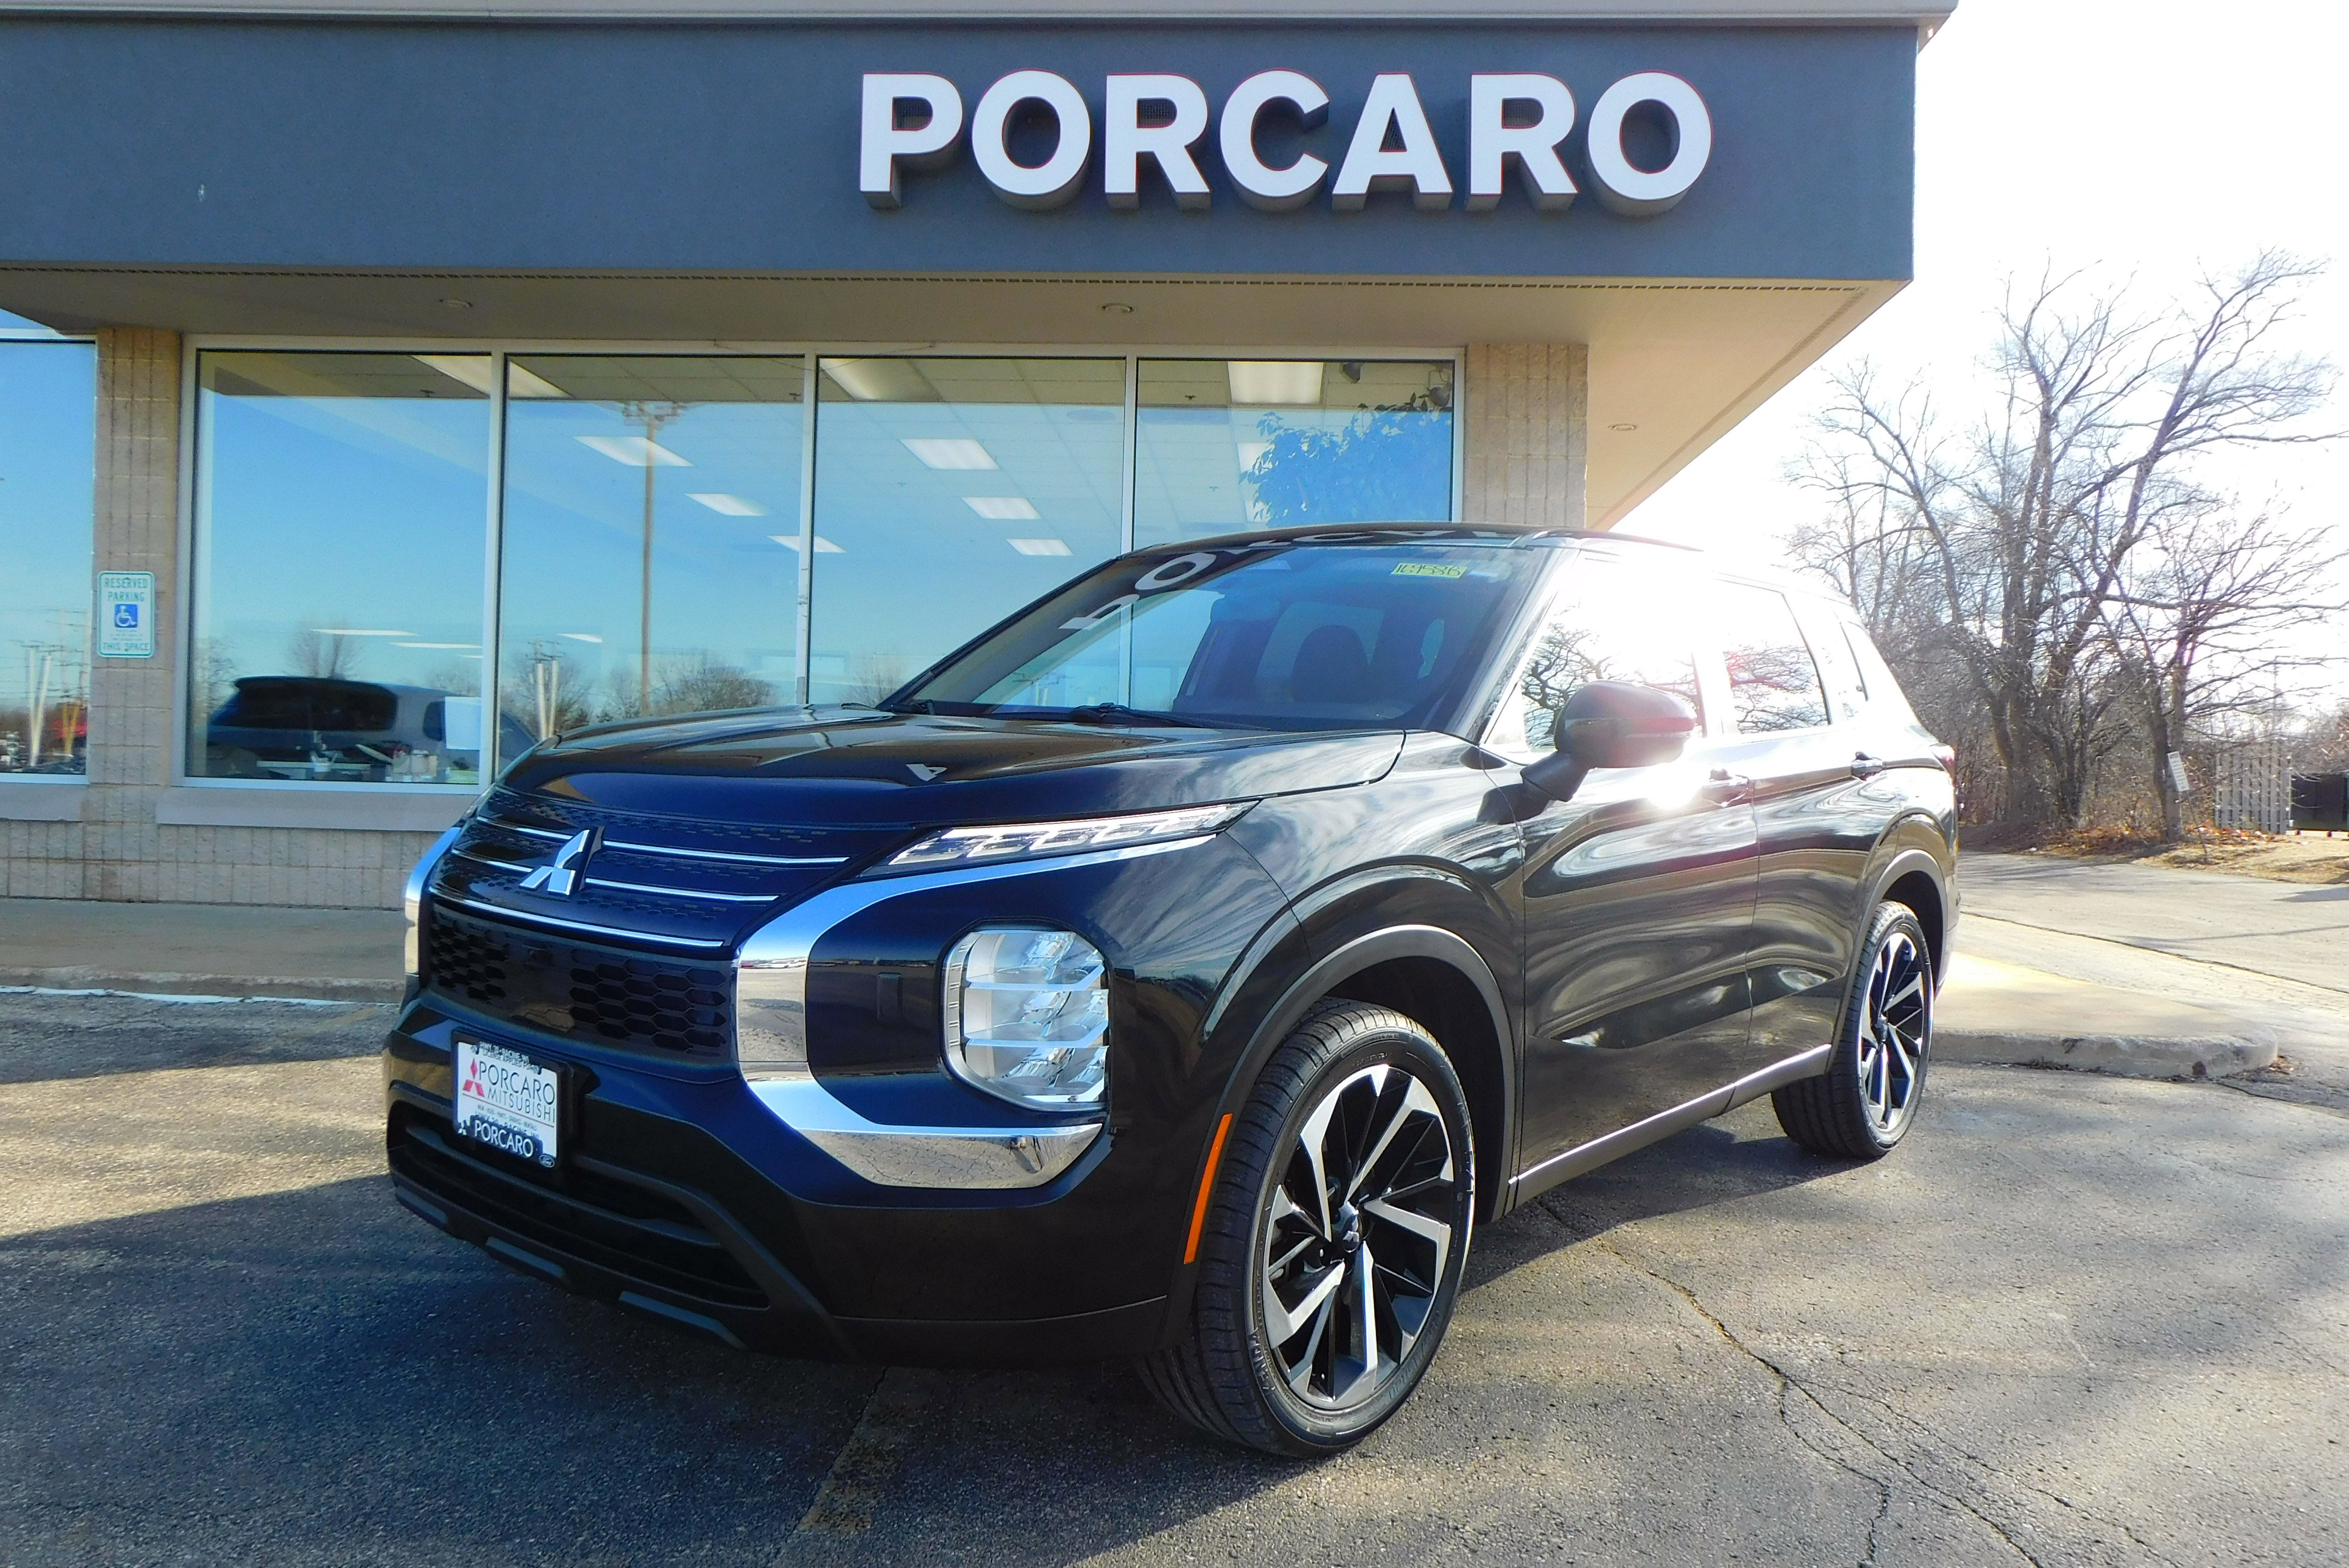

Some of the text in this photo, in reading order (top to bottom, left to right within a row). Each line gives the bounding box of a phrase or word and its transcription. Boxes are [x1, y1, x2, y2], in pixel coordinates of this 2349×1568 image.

[859, 68, 1713, 201] PORCARO
[104, 578, 148, 588] RESERVED
[108, 592, 145, 602] PARKING
[103, 642, 121, 651] THIS
[124, 642, 149, 651] SPACE
[479, 1060, 555, 1105] PORCARO
[488, 1087, 555, 1123] MITSUBISHI
[475, 1119, 534, 1158] PORCARO
